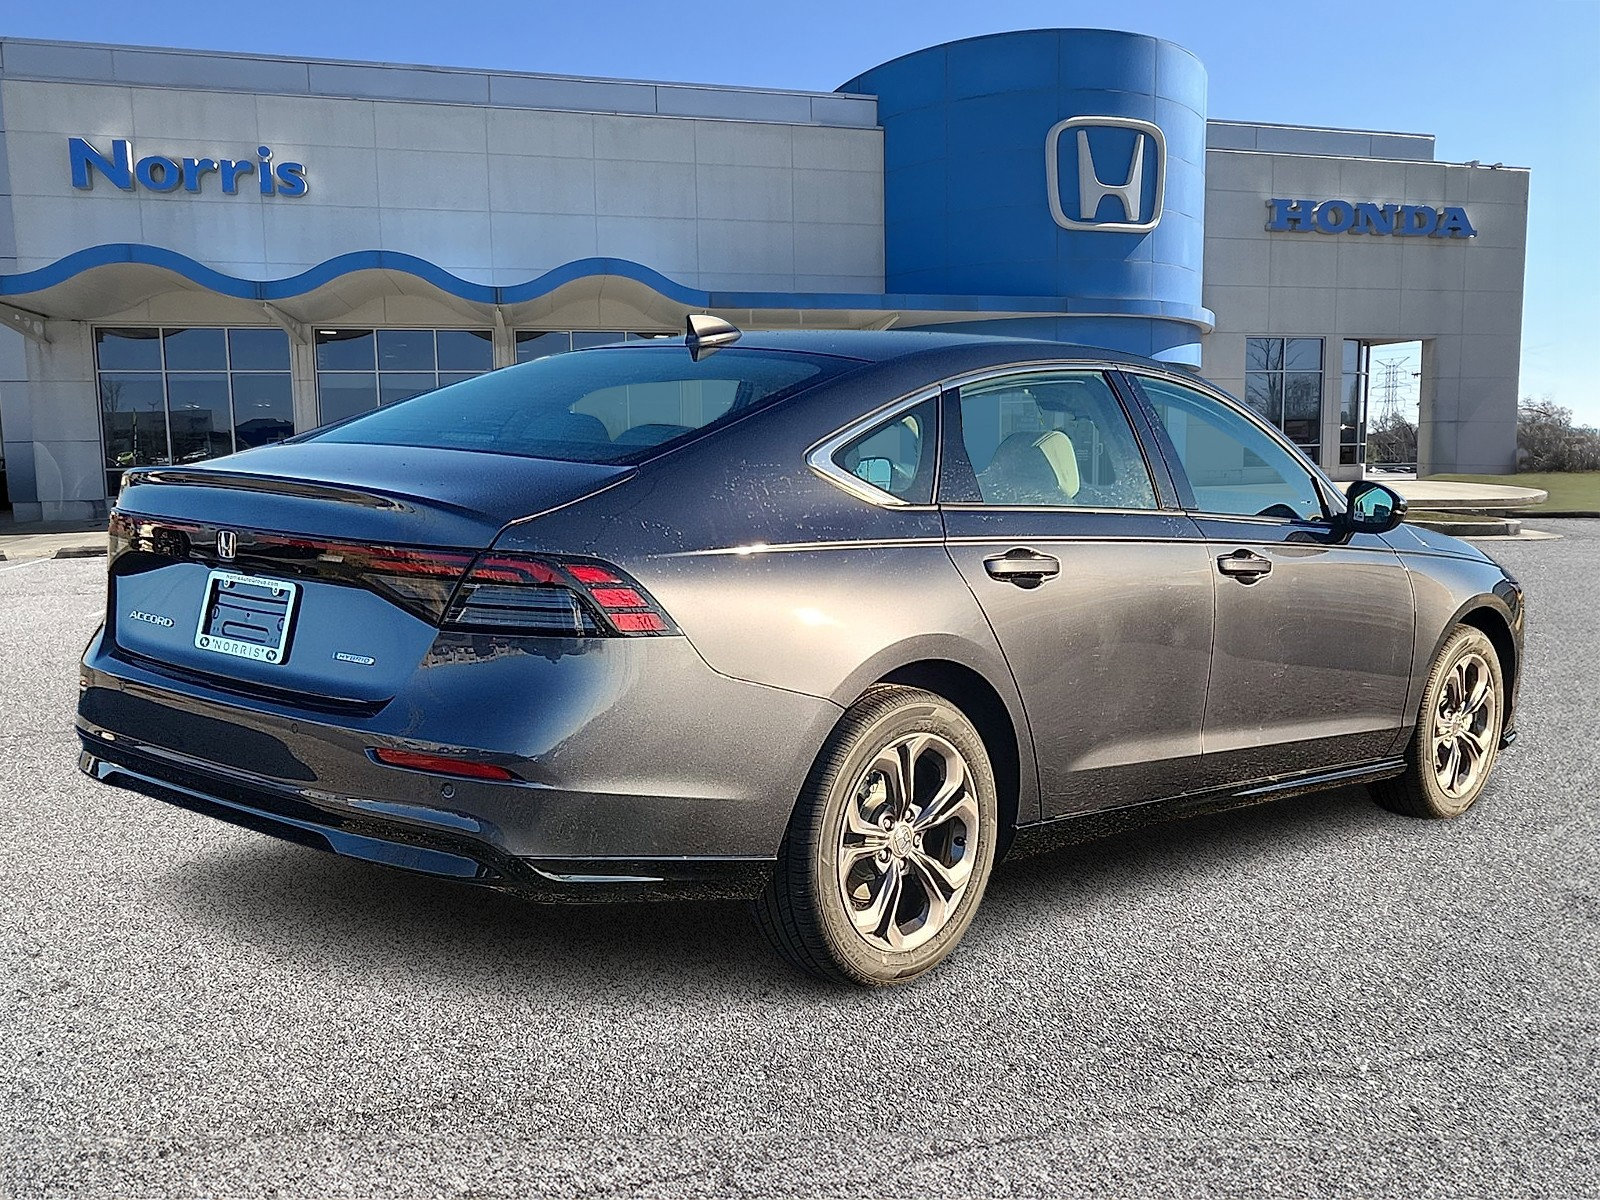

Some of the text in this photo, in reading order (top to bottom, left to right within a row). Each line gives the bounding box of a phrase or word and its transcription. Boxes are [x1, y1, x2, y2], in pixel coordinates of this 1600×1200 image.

[68, 137, 309, 197] Norris
[1265, 198, 1478, 238] HONDA
[129, 610, 174, 627] ACCORD
[338, 653, 371, 664] HYBRID
